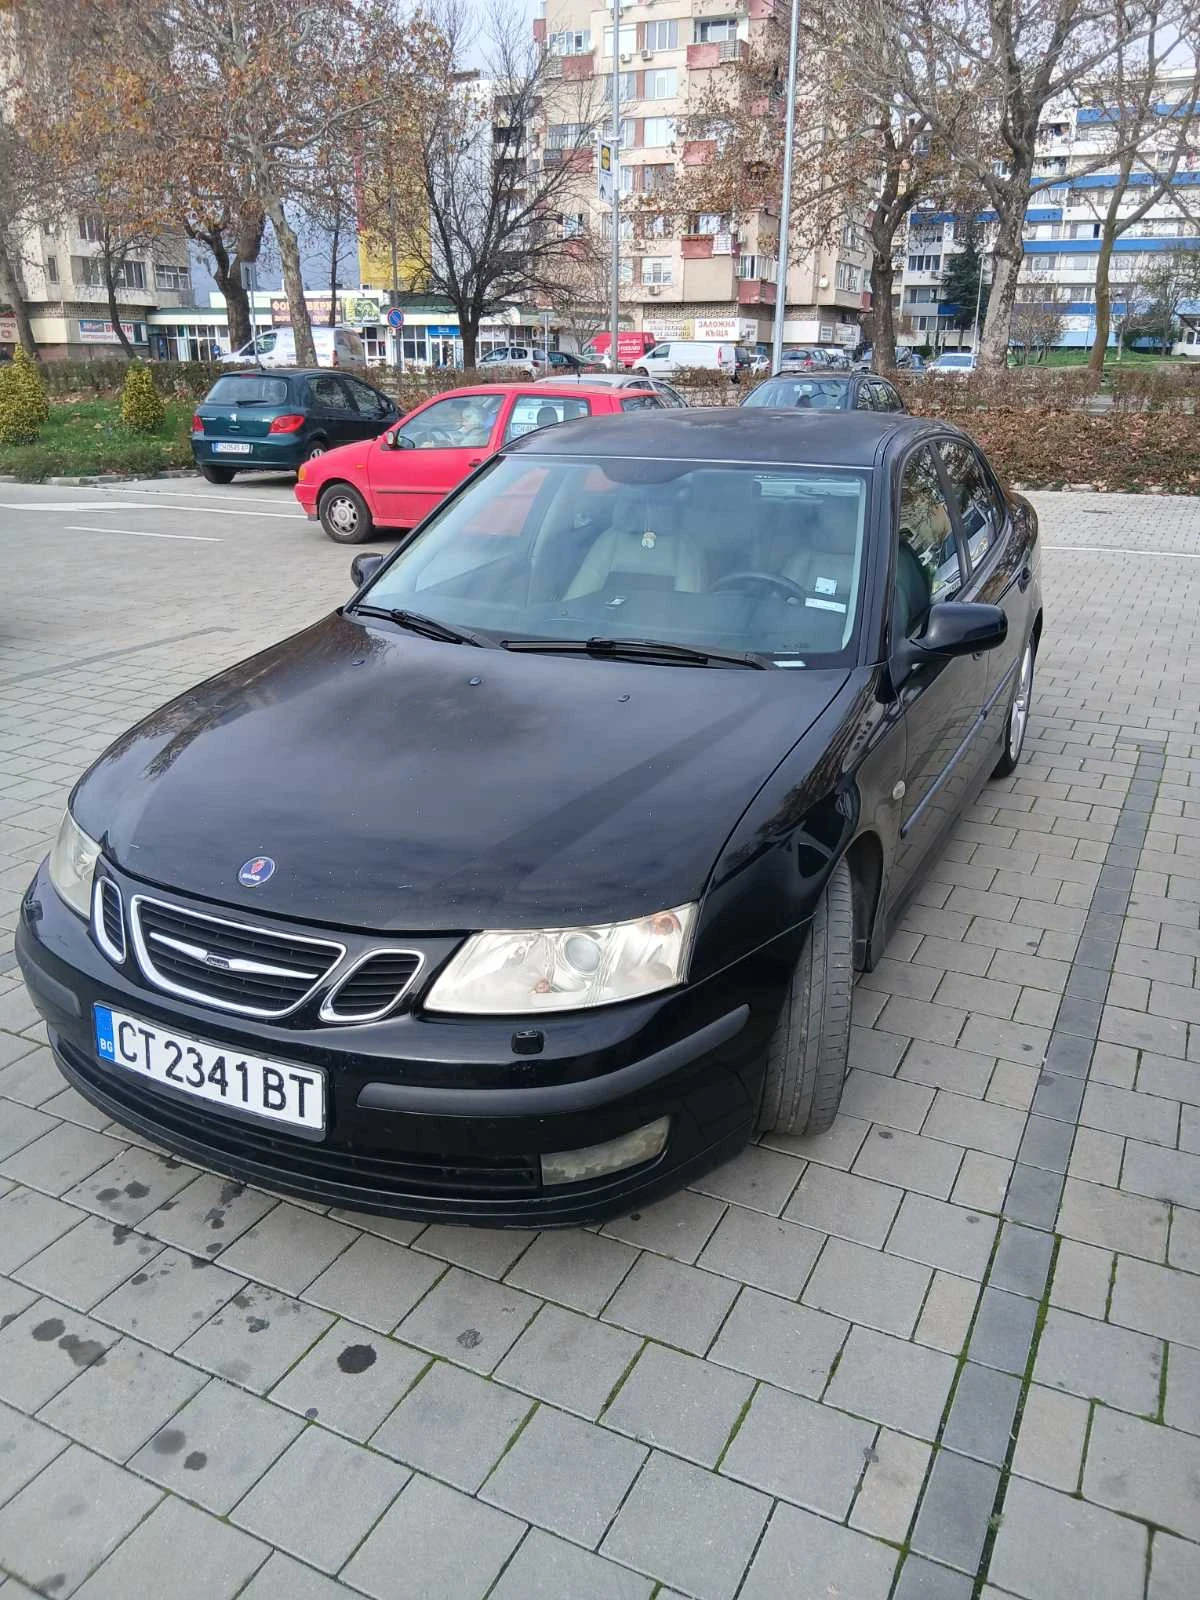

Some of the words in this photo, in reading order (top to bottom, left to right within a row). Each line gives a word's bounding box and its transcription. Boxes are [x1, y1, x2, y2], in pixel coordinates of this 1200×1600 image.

[698, 320, 736, 329] ЗАЛОЖНА
[705, 330, 729, 338] КЪЩА
[100, 1038, 113, 1053] BG
